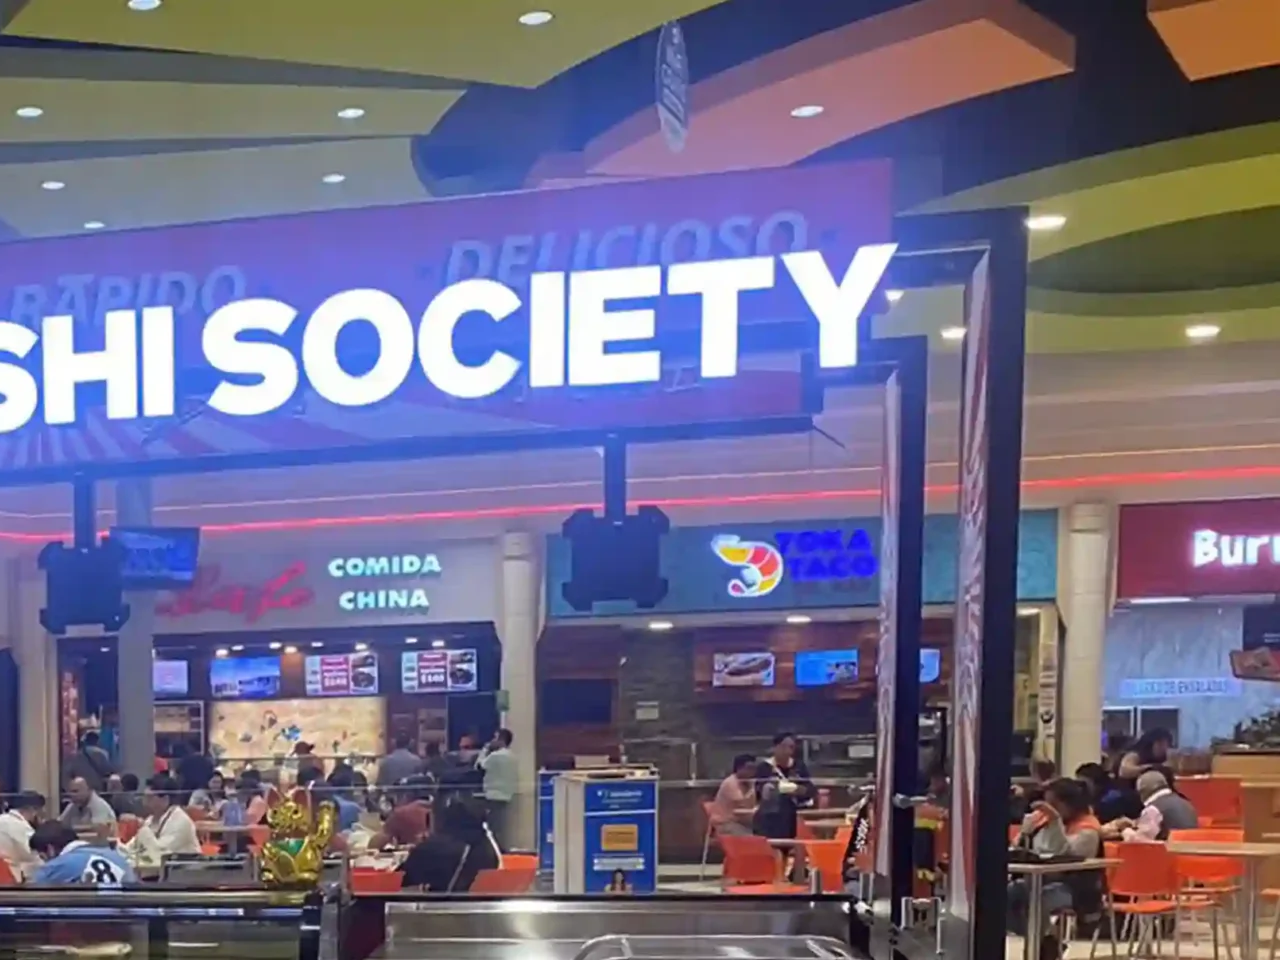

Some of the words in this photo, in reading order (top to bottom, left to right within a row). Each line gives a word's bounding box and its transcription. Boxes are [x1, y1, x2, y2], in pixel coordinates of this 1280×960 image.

[202, 243, 899, 416] SOCIETY
[327, 554, 442, 577] COMIDA
[338, 588, 430, 611] CHINA
[91, 858, 118, 883] 8
